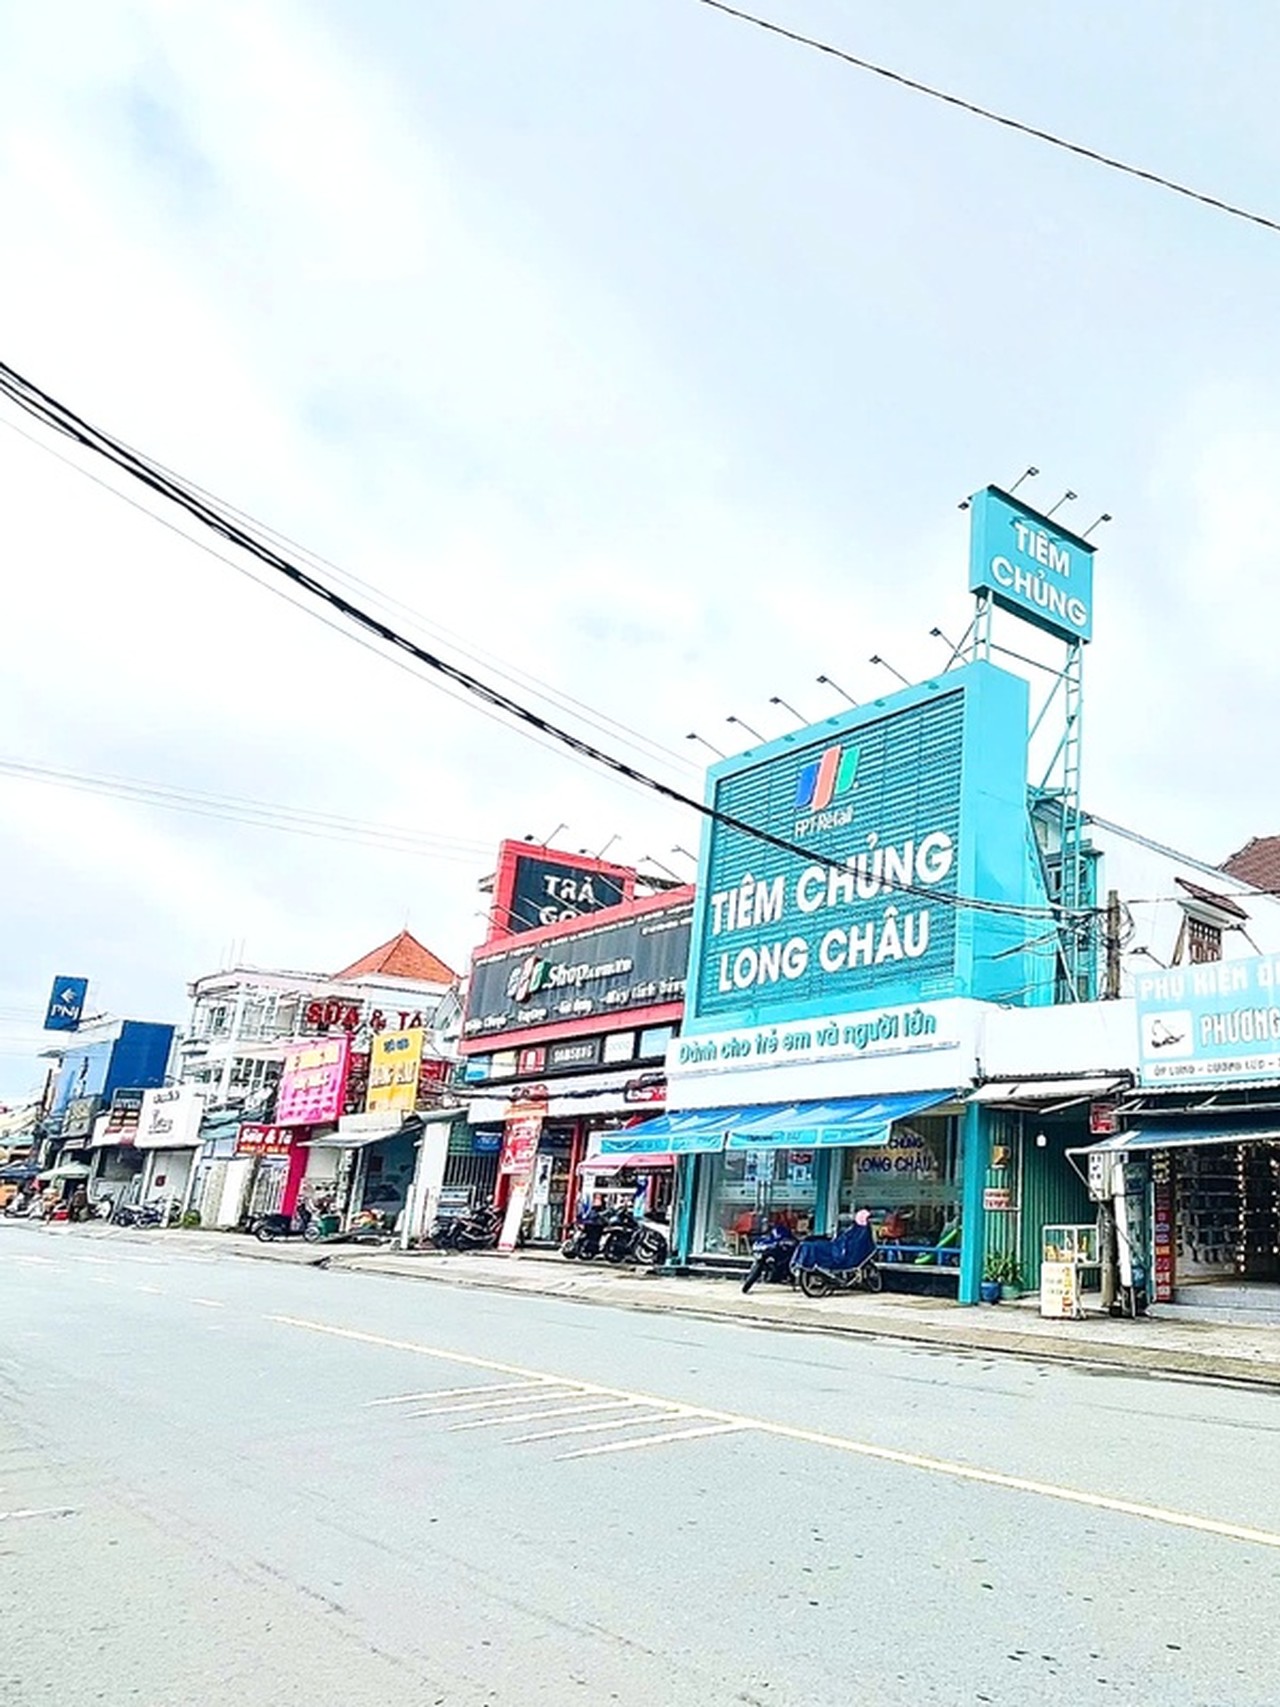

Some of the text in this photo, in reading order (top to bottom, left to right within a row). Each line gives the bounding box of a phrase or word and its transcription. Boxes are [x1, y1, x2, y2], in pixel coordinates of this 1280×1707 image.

[1014, 521, 1071, 578] TIÊM
[990, 555, 1088, 627] CHỦNG
[709, 831, 953, 936] TIÊM CHỦNG
[718, 936, 809, 993] LONG
[818, 905, 931, 973] CHÂU
[1140, 976, 1184, 1000] PHỤ
[1193, 963, 1248, 995] KIỆN
[51, 1003, 81, 1021] PNJ
[370, 1009, 387, 1031] &
[678, 1007, 937, 1065] Dành cho trẻ em và người lớn
[857, 1156, 892, 1173] LONG
